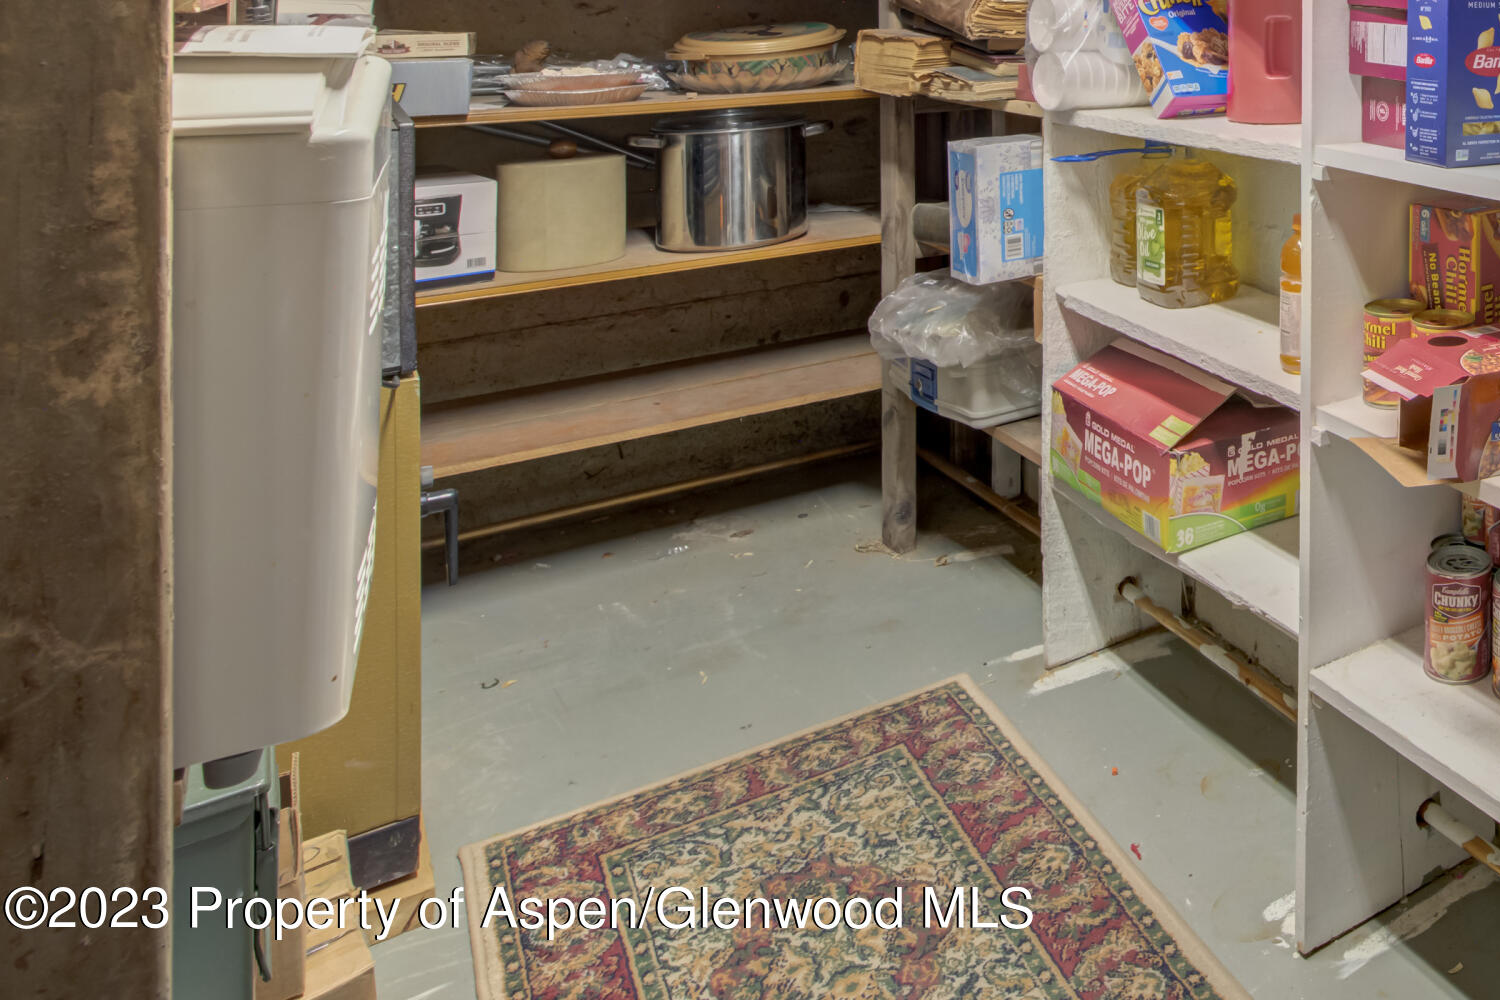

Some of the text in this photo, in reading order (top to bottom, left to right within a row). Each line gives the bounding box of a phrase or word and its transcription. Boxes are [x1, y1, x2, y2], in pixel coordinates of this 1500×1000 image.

[1168, 9, 1196, 19] Original
[1468, 1, 1496, 9] MEDIUM
[1428, 252, 1437, 270] No
[1445, 254, 1458, 304] Chili
[1068, 368, 1117, 397] MEGA-POP
[1091, 420, 1110, 439] GOLD
[1266, 433, 1299, 446] MEDAL
[1084, 429, 1152, 489] MEGA-POP
[1176, 528, 1194, 548] 36
[1434, 592, 1479, 607] CHUNKY
